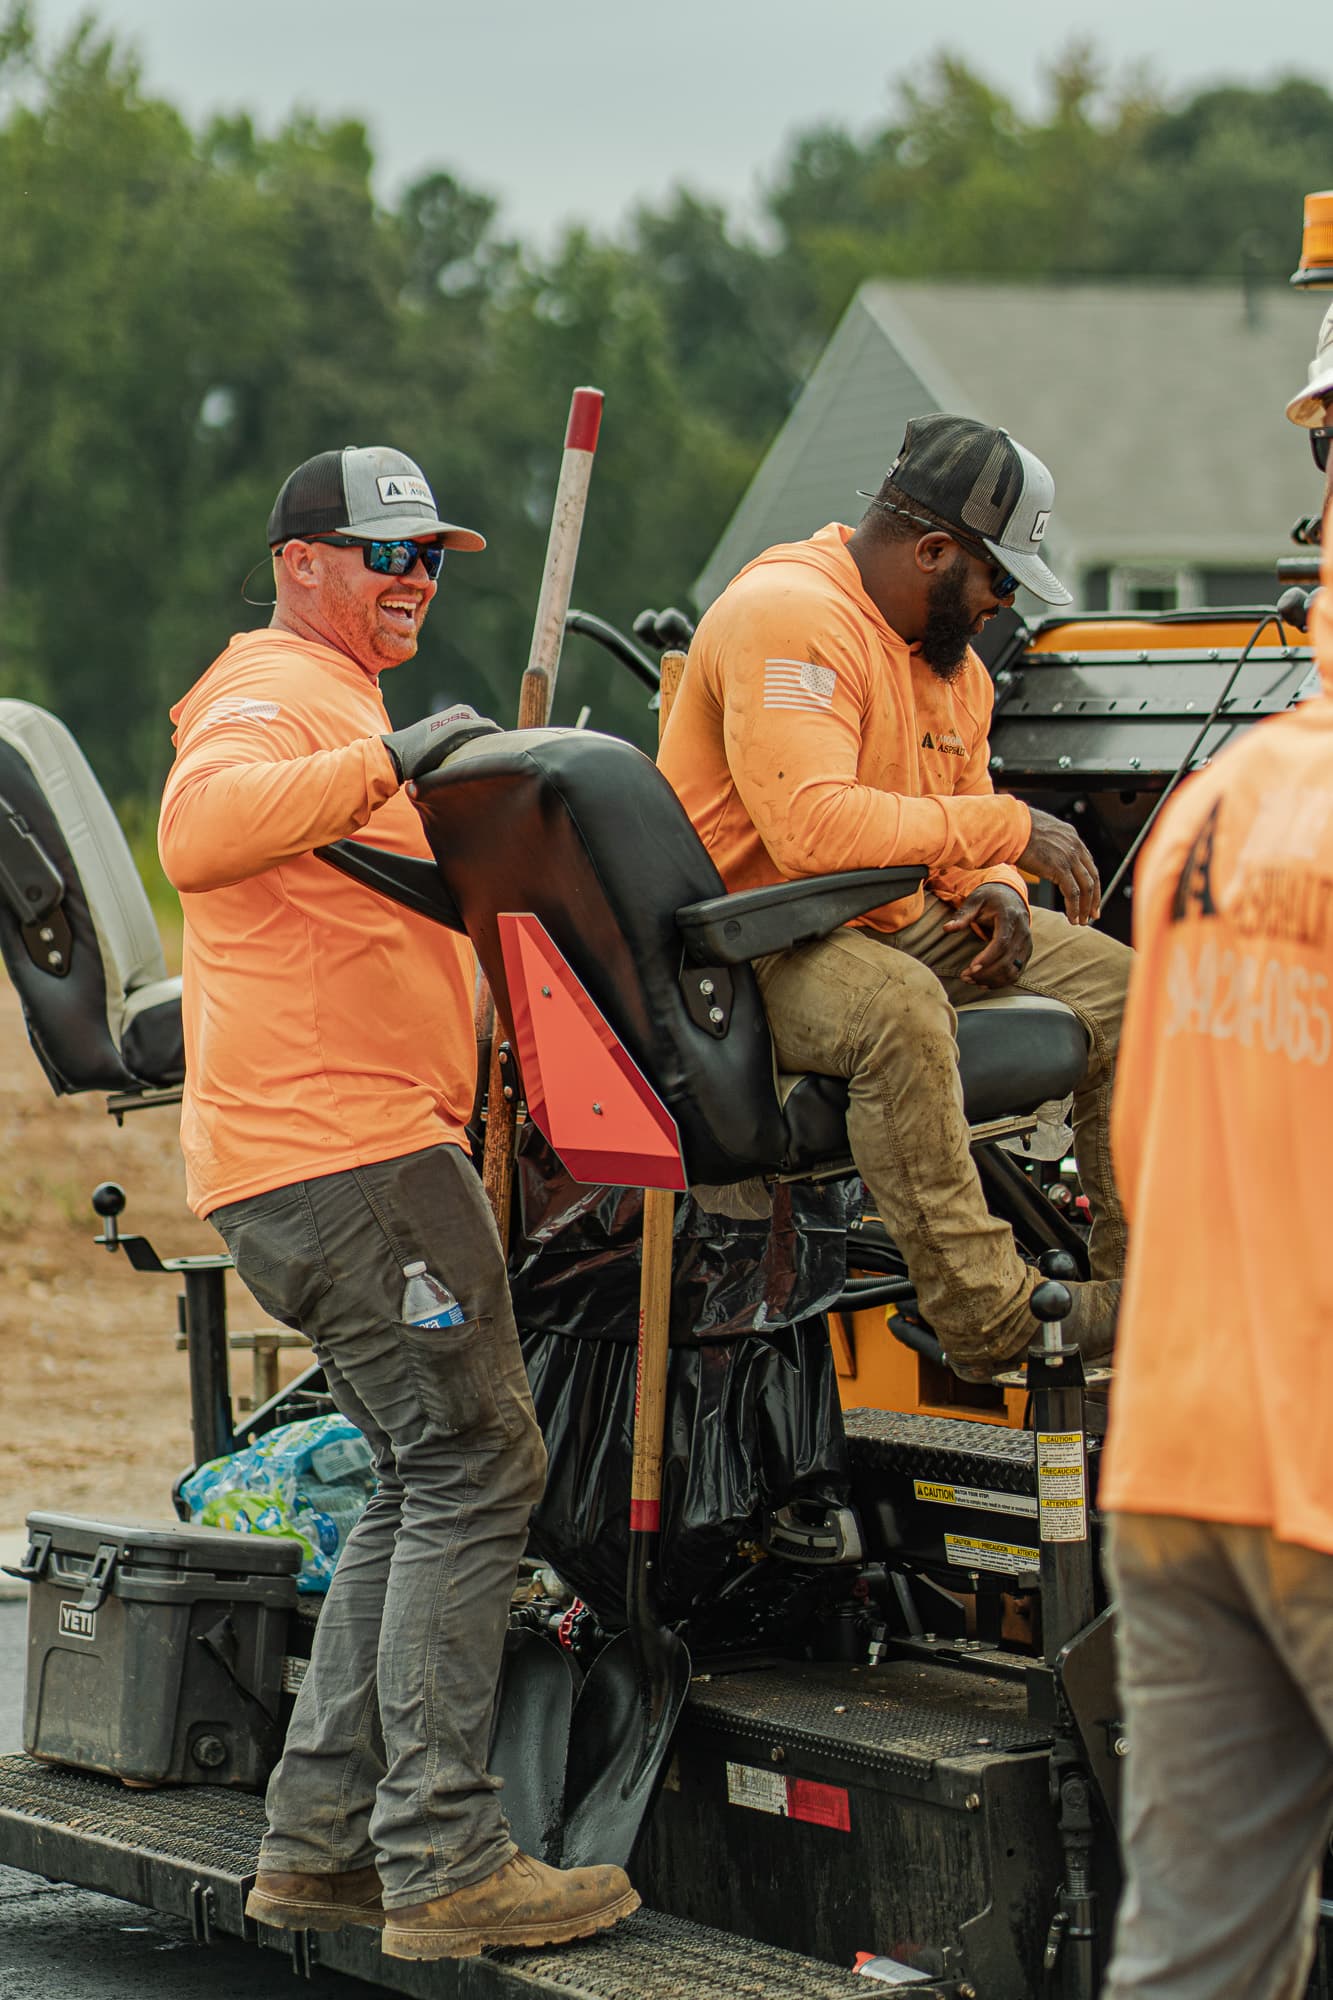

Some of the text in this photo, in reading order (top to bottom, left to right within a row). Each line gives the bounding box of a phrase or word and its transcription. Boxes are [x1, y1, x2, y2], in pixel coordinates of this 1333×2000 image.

[921, 731, 935, 750] A
[1046, 1435, 1073, 1443] CAUTION
[923, 1486, 954, 1501] CAUTION
[62, 1607, 93, 1634] YETI
